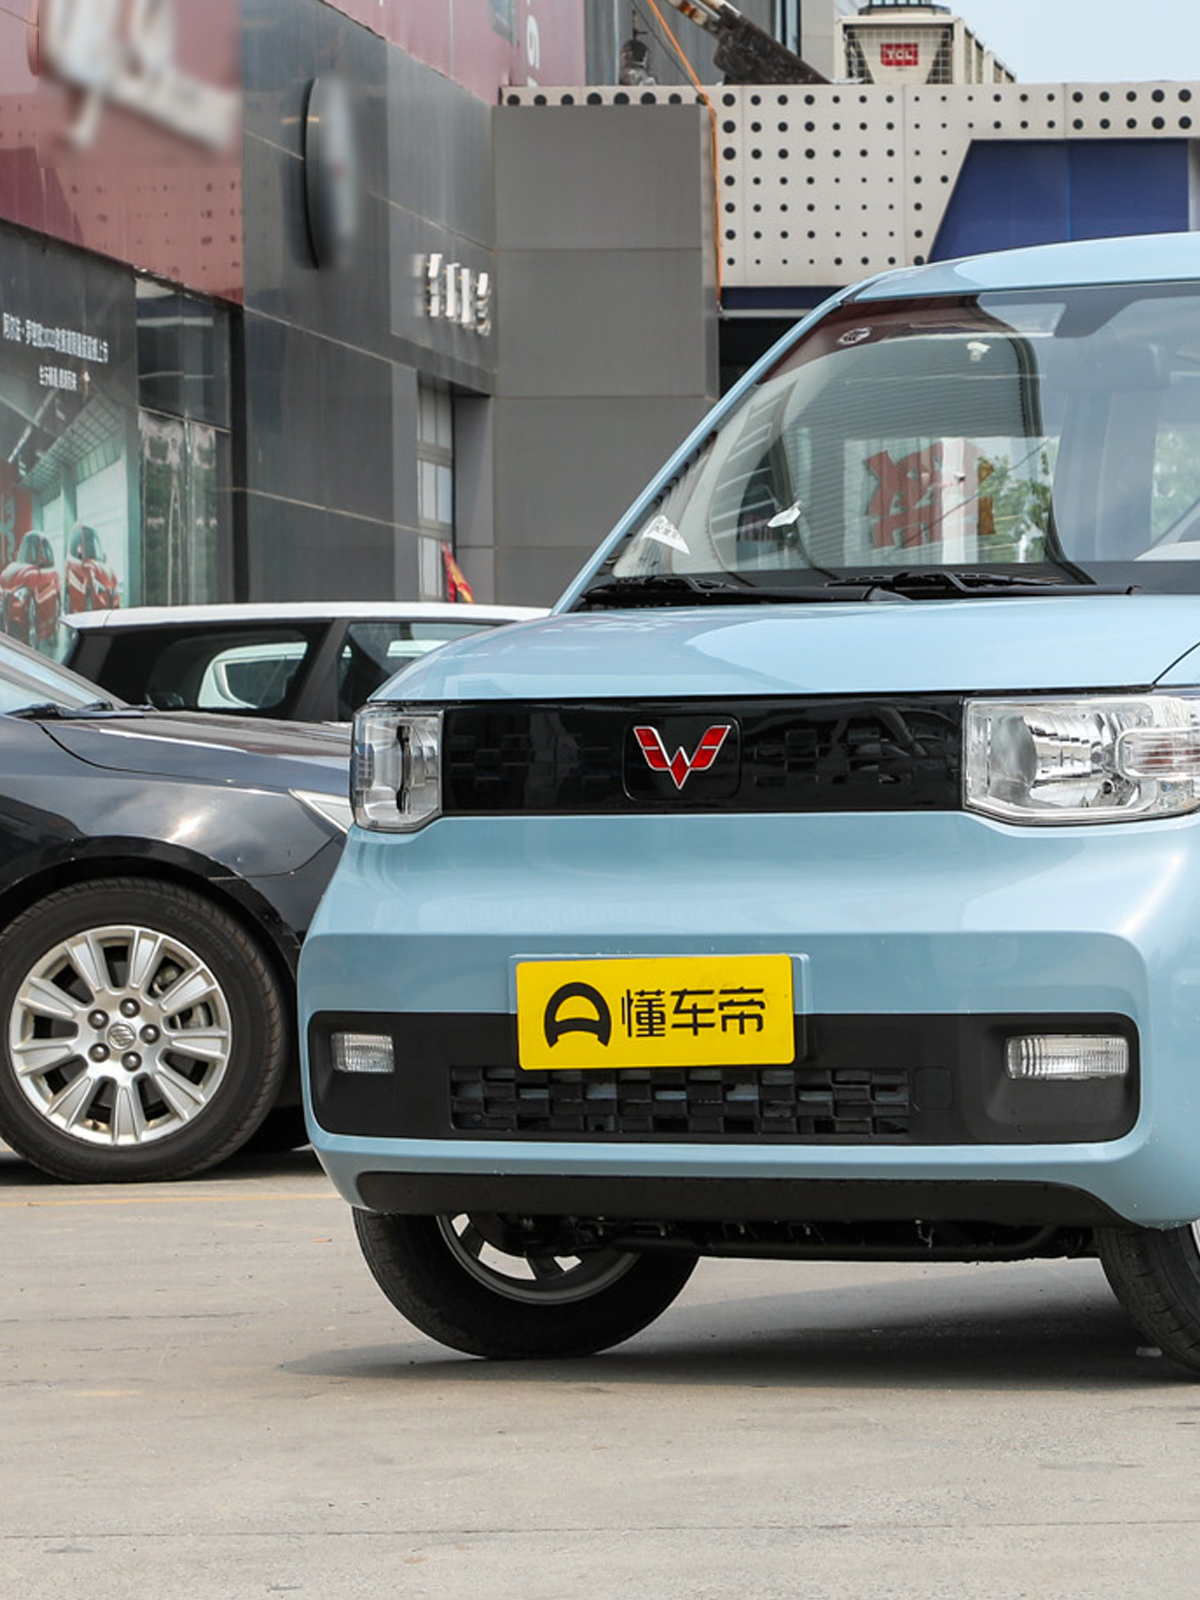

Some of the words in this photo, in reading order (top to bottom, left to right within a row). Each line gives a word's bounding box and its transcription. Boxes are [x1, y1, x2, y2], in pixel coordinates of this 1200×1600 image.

[884, 47, 915, 61] TCL
[621, 986, 767, 1038] 懂车帝
